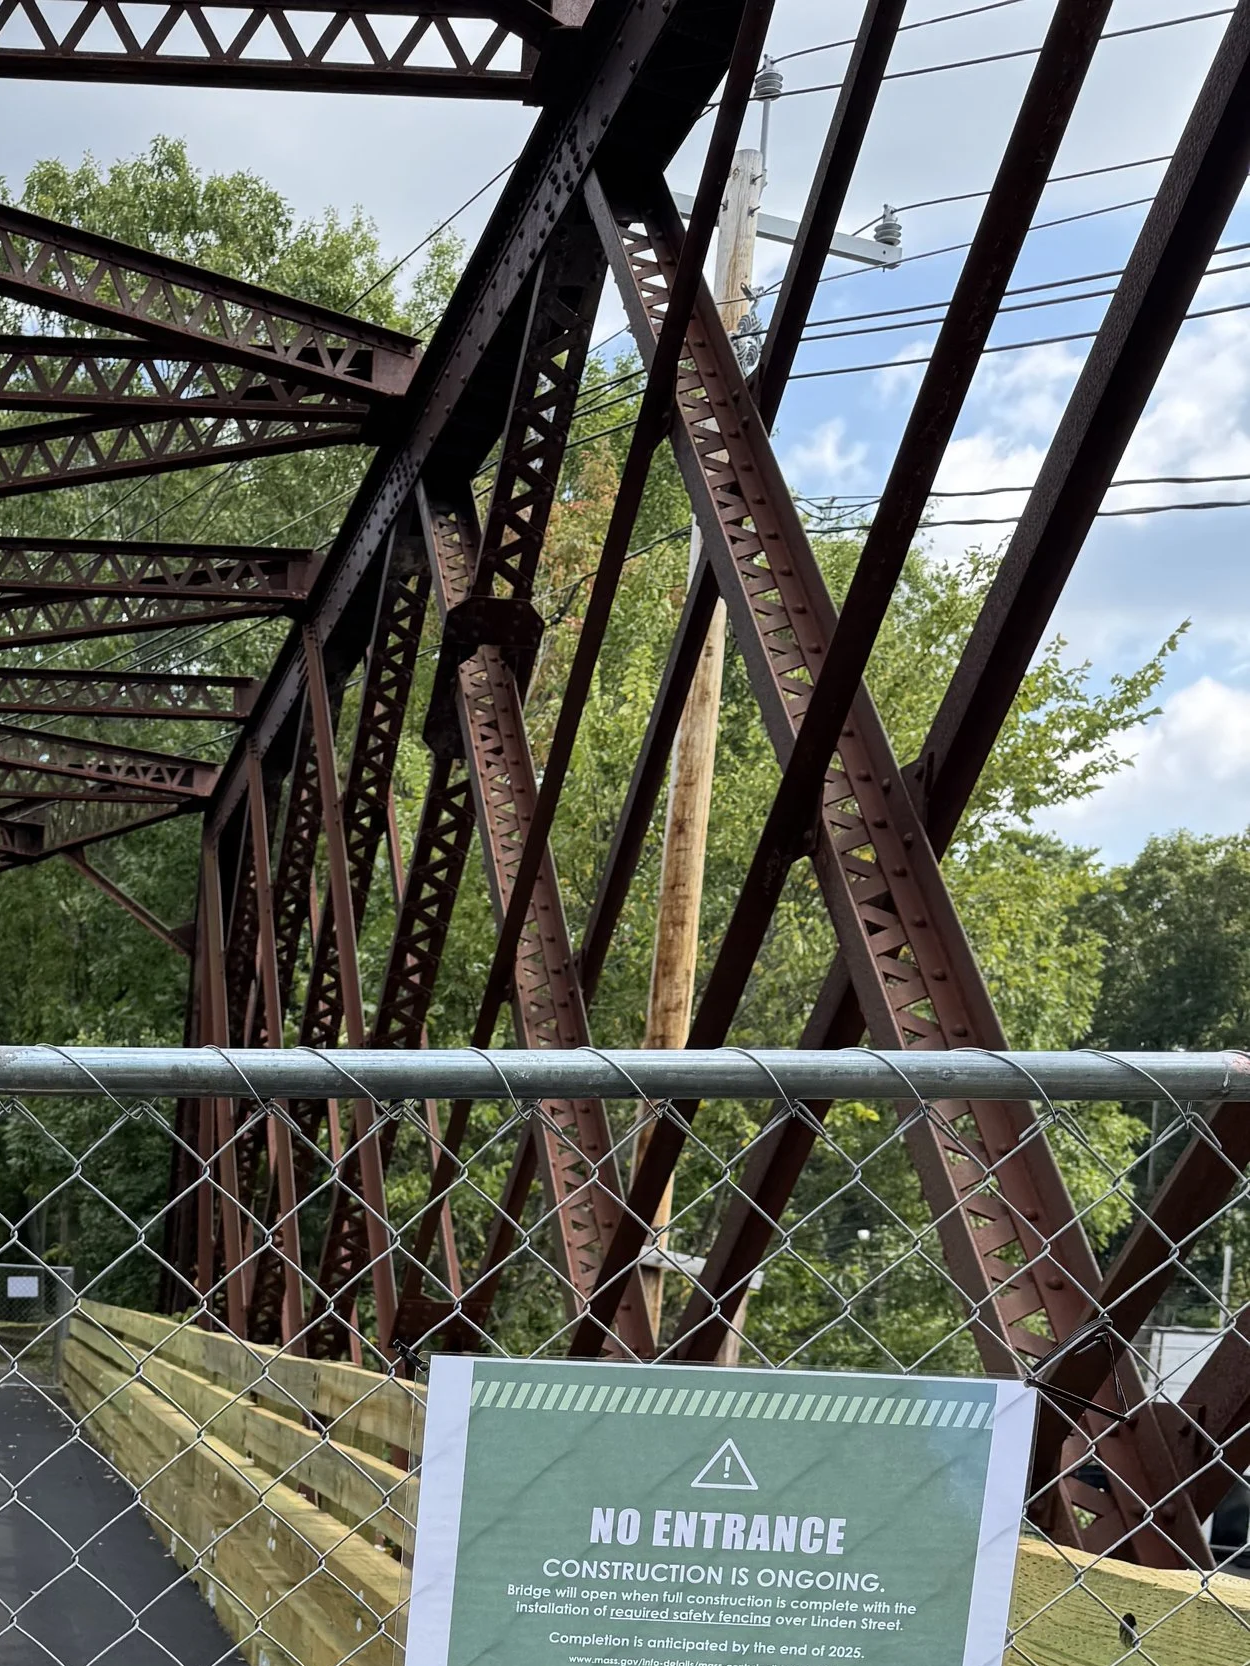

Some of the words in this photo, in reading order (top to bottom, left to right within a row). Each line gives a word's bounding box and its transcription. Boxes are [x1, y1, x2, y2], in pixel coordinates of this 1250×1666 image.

[590, 1506, 642, 1546] NO
[652, 1508, 847, 1555] ENTRANCE
[542, 1558, 723, 1585] CONSTRUCTION
[731, 1567, 749, 1586] IS
[756, 1568, 885, 1593] ONGOING.
[507, 1584, 551, 1600] Bridge
[555, 1586, 577, 1598] will
[581, 1589, 617, 1602] open
[621, 1590, 659, 1603] when
[662, 1591, 683, 1604] full
[686, 1594, 772, 1608] construction
[776, 1597, 787, 1608] is
[790, 1599, 859, 1613] complete
[862, 1601, 890, 1614] with
[894, 1602, 917, 1615] the
[516, 1600, 590, 1616] installation
[593, 1604, 608, 1617] of
[610, 1606, 669, 1620] required
[672, 1608, 715, 1623] safety
[718, 1611, 771, 1626] fencing
[775, 1615, 807, 1627] over
[811, 1615, 857, 1629] Linden
[861, 1617, 903, 1631] Street.
[549, 1631, 630, 1647] Completion
[633, 1635, 643, 1648] is
[647, 1636, 728, 1653] anticipated
[732, 1641, 749, 1655] by
[753, 1641, 776, 1654] the
[779, 1643, 807, 1656] end
[811, 1643, 826, 1657] of
[828, 1646, 865, 1659] 2025.
